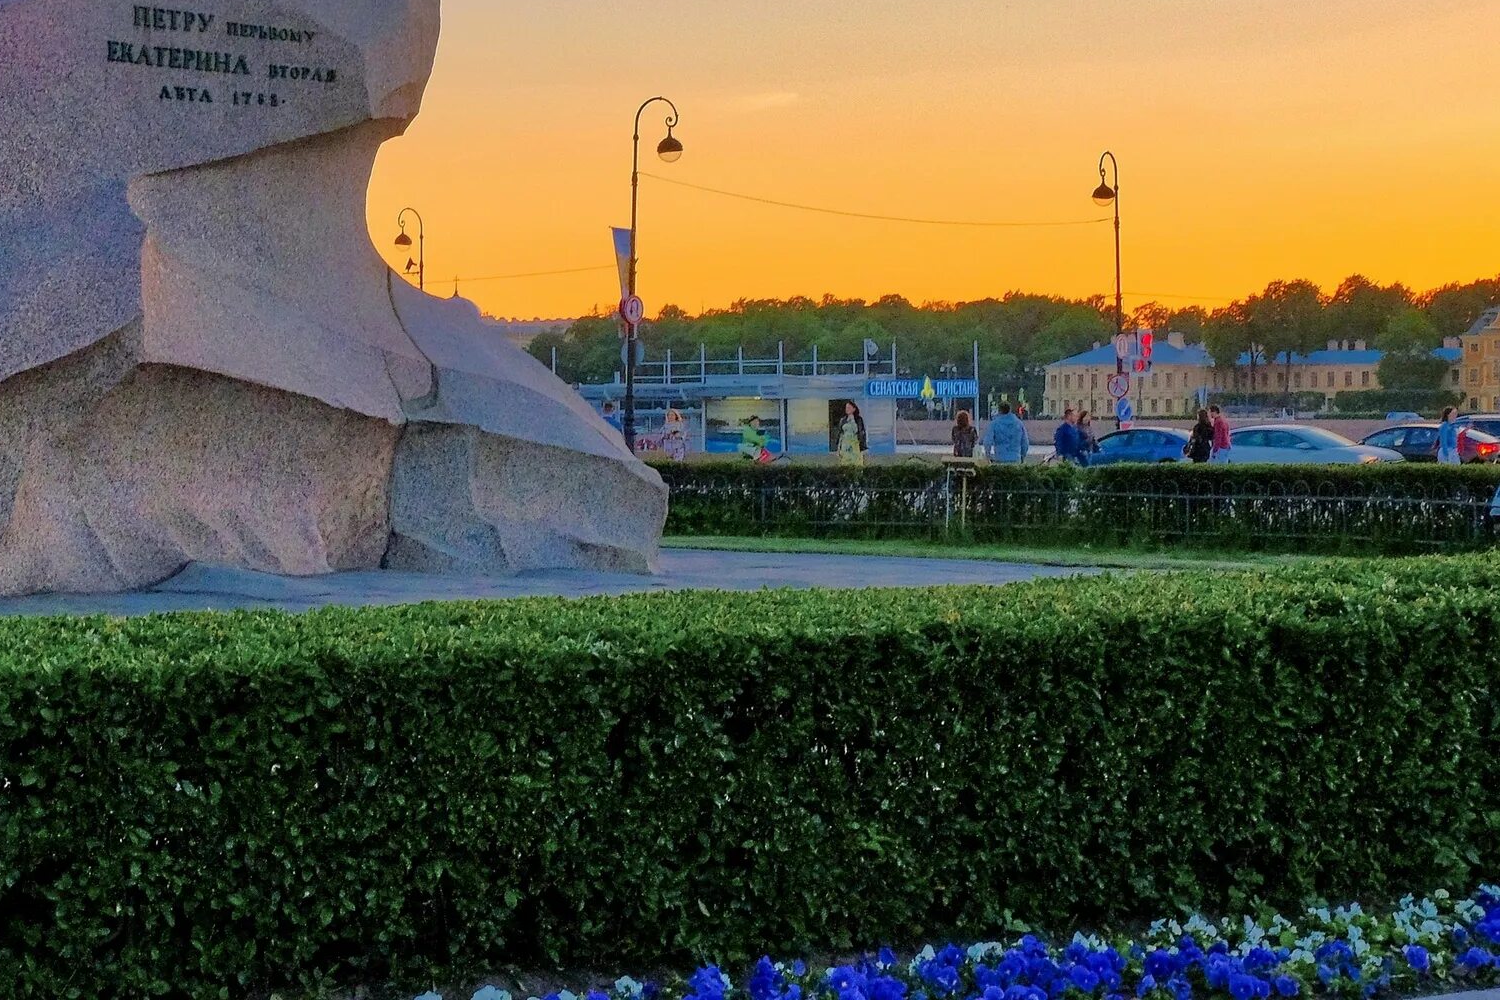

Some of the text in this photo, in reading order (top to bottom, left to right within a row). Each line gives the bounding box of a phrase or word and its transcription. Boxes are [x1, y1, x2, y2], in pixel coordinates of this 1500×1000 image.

[133, 5, 215, 32] ПЕТРУ
[106, 40, 337, 83] ЕКАТЕРИНА ВТОРАЯ
[870, 381, 978, 396] СЕНАТСКАЯ ПРИСТАНЬ
